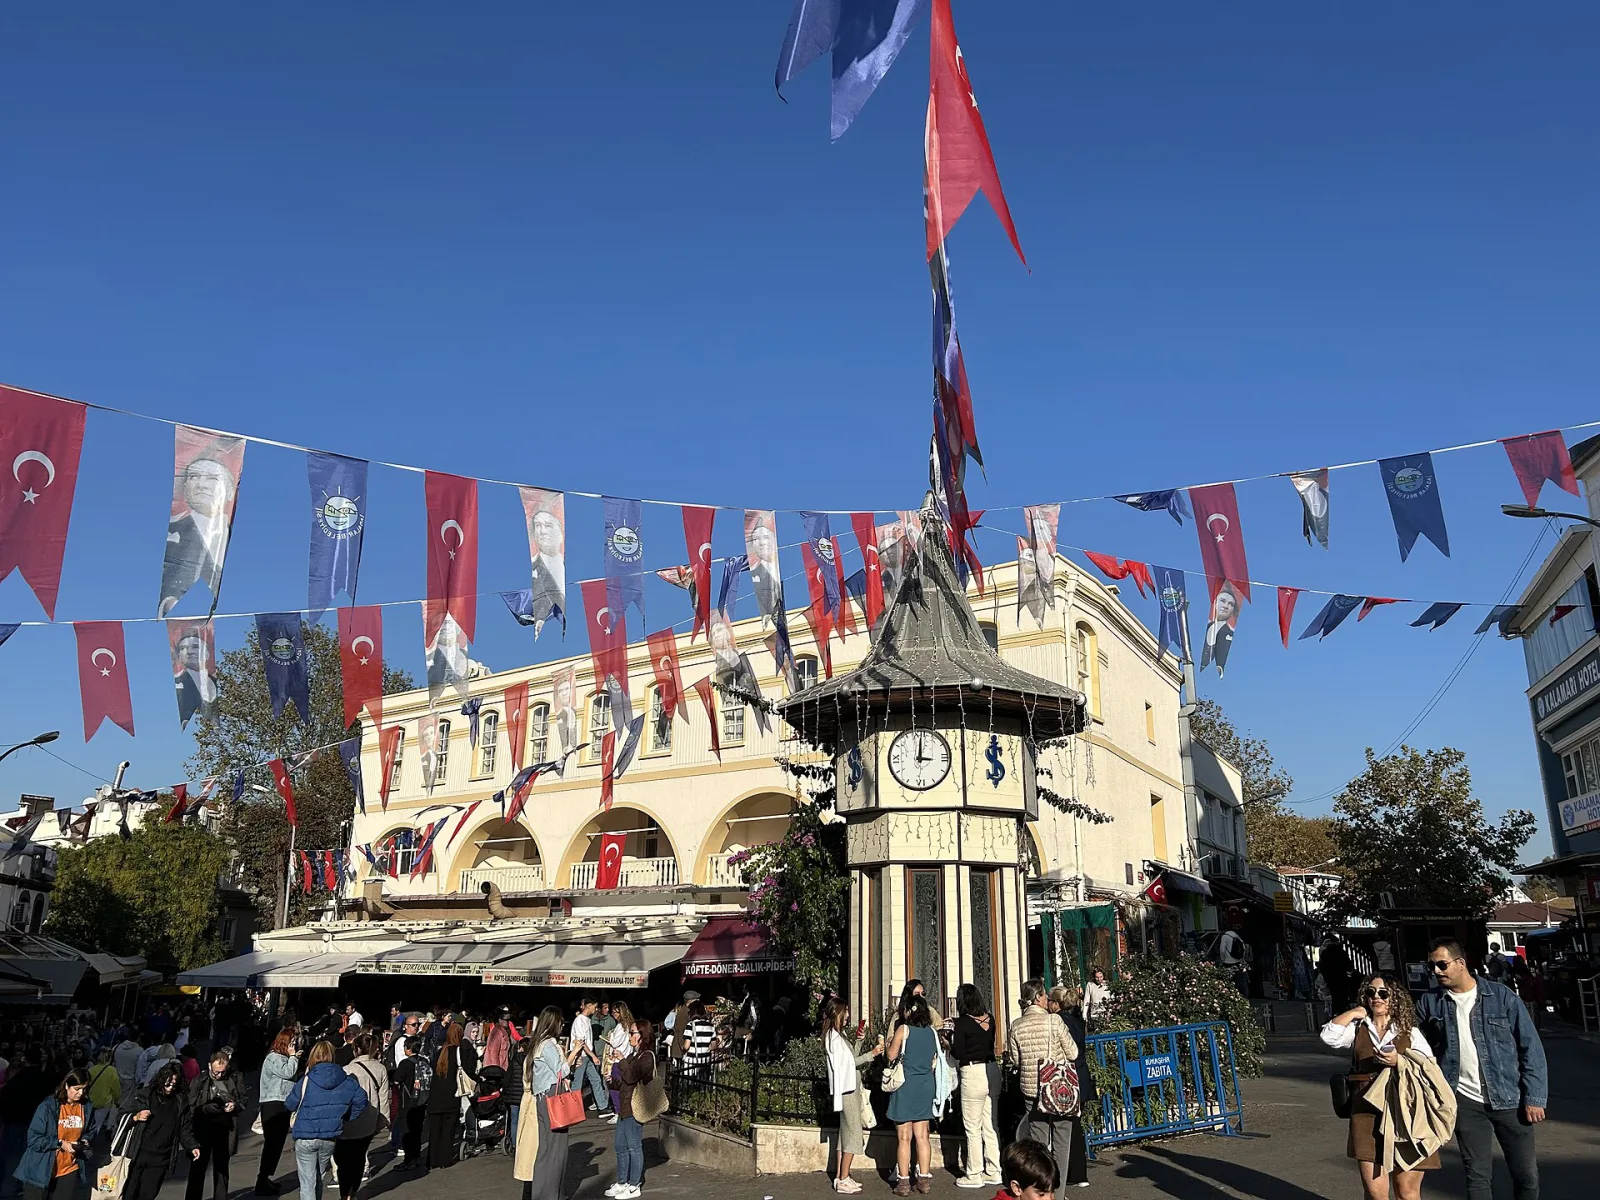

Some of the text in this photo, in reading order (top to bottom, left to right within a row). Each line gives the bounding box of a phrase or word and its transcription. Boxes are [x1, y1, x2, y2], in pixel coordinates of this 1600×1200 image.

[1577, 660, 1600, 690] HOTEL
[1573, 793, 1600, 812] KALAMA
[403, 963, 438, 971] FORTUNATO
[1147, 1065, 1172, 1078] ZABITA
